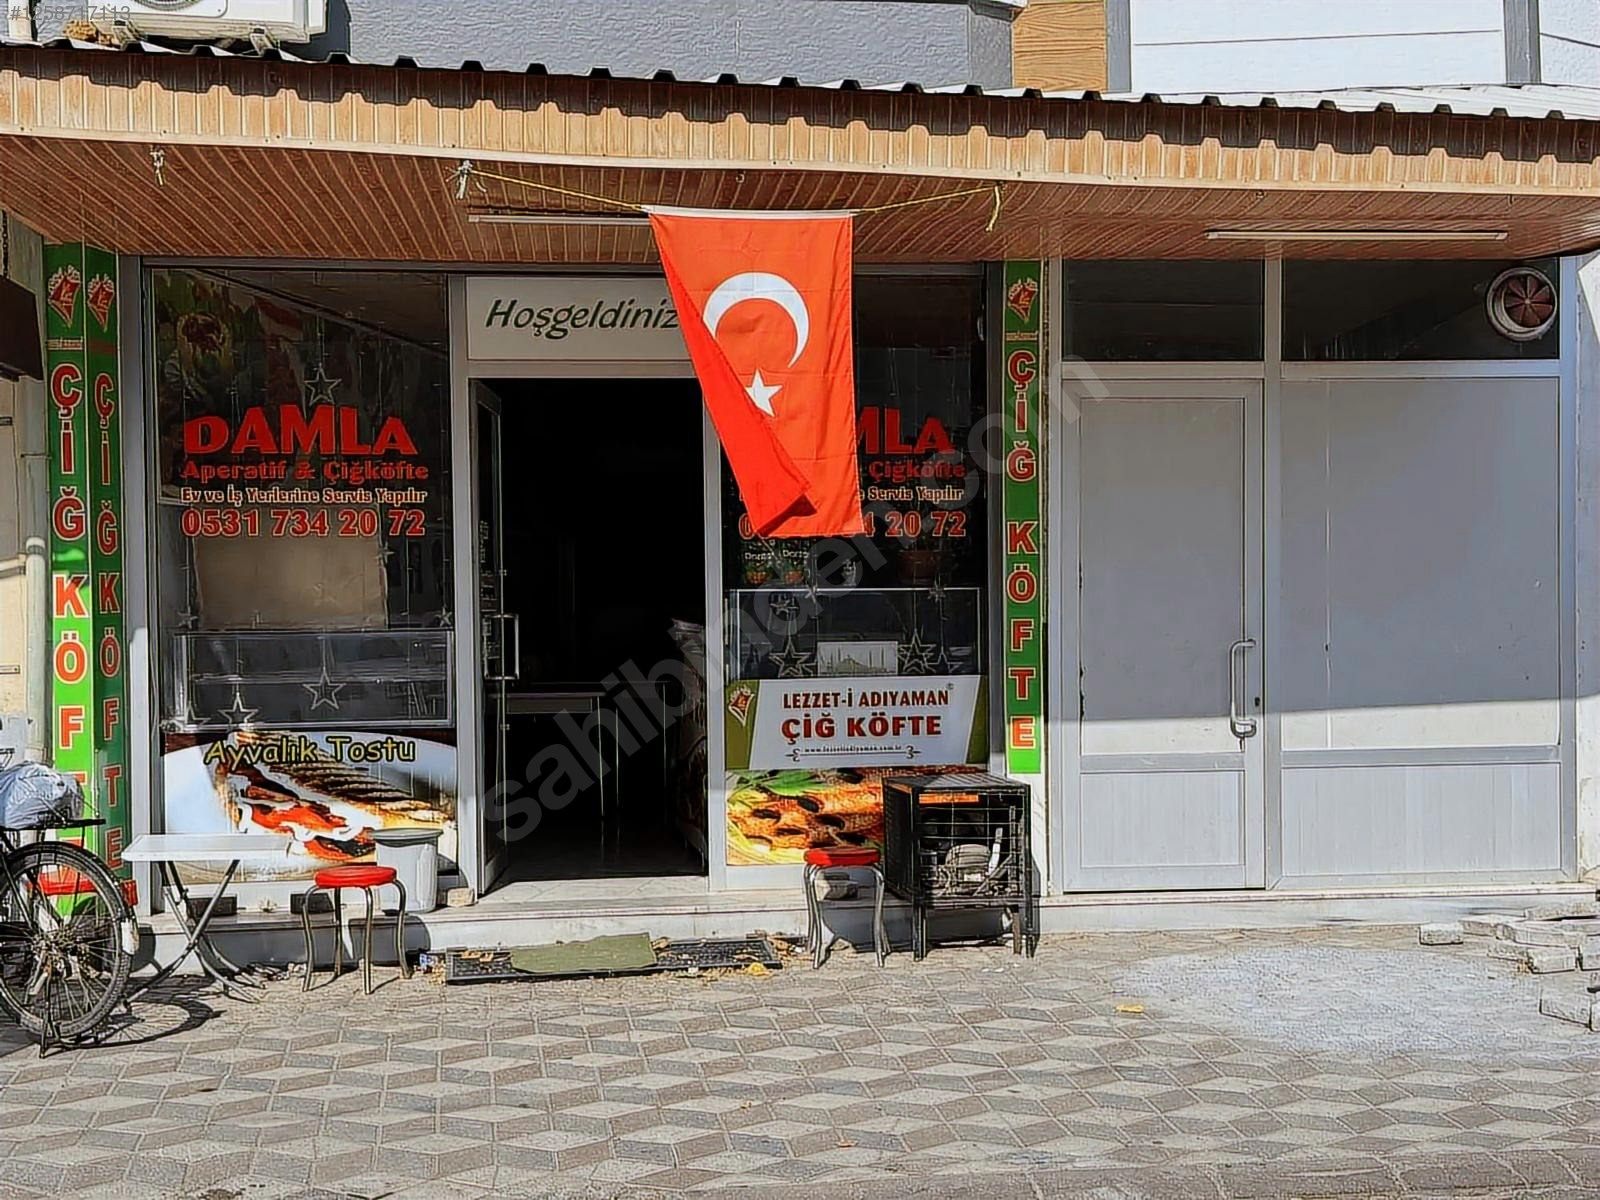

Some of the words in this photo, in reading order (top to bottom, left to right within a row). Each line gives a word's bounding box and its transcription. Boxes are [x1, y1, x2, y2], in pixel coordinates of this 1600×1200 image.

[485, 298, 679, 340] Hoşgeldiniz
[184, 404, 418, 455] DAMLA
[180, 460, 287, 484] Aperatif
[181, 486, 201, 503] Ev
[204, 490, 224, 503] ve
[227, 483, 243, 507] İş
[245, 486, 319, 503] Yerlerine
[323, 487, 372, 503] Servis
[868, 486, 912, 501] Servis
[182, 508, 258, 537] 0531
[271, 508, 329, 537] 734
[339, 508, 377, 537] 20
[388, 508, 425, 537] 72
[885, 511, 922, 537] 20
[931, 511, 967, 537] 72
[783, 688, 853, 709] LEZZET-İ
[859, 690, 948, 708] ADIYAMAN
[781, 712, 836, 745] ÇİĞ
[847, 712, 942, 739] KÖFTE
[326, 735, 416, 762] Tostu
